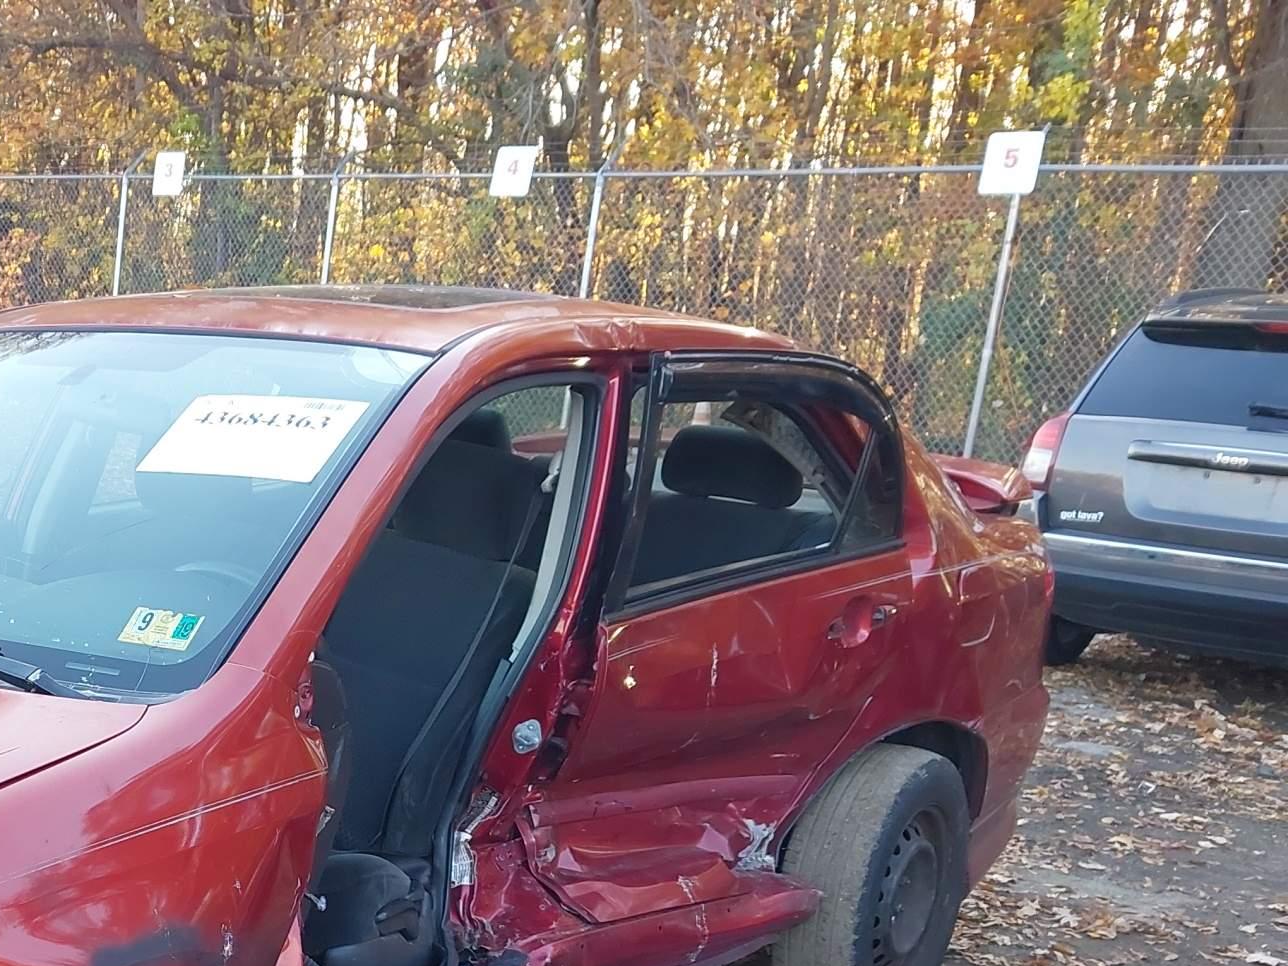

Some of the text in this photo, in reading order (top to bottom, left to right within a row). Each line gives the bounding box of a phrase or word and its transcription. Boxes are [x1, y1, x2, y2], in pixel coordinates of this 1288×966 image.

[507, 159, 519, 175] 4
[1003, 148, 1020, 168] 5
[164, 163, 173, 177] 3
[194, 410, 331, 430] 43684363
[1210, 451, 1249, 468] Jeep
[137, 612, 155, 631] 9
